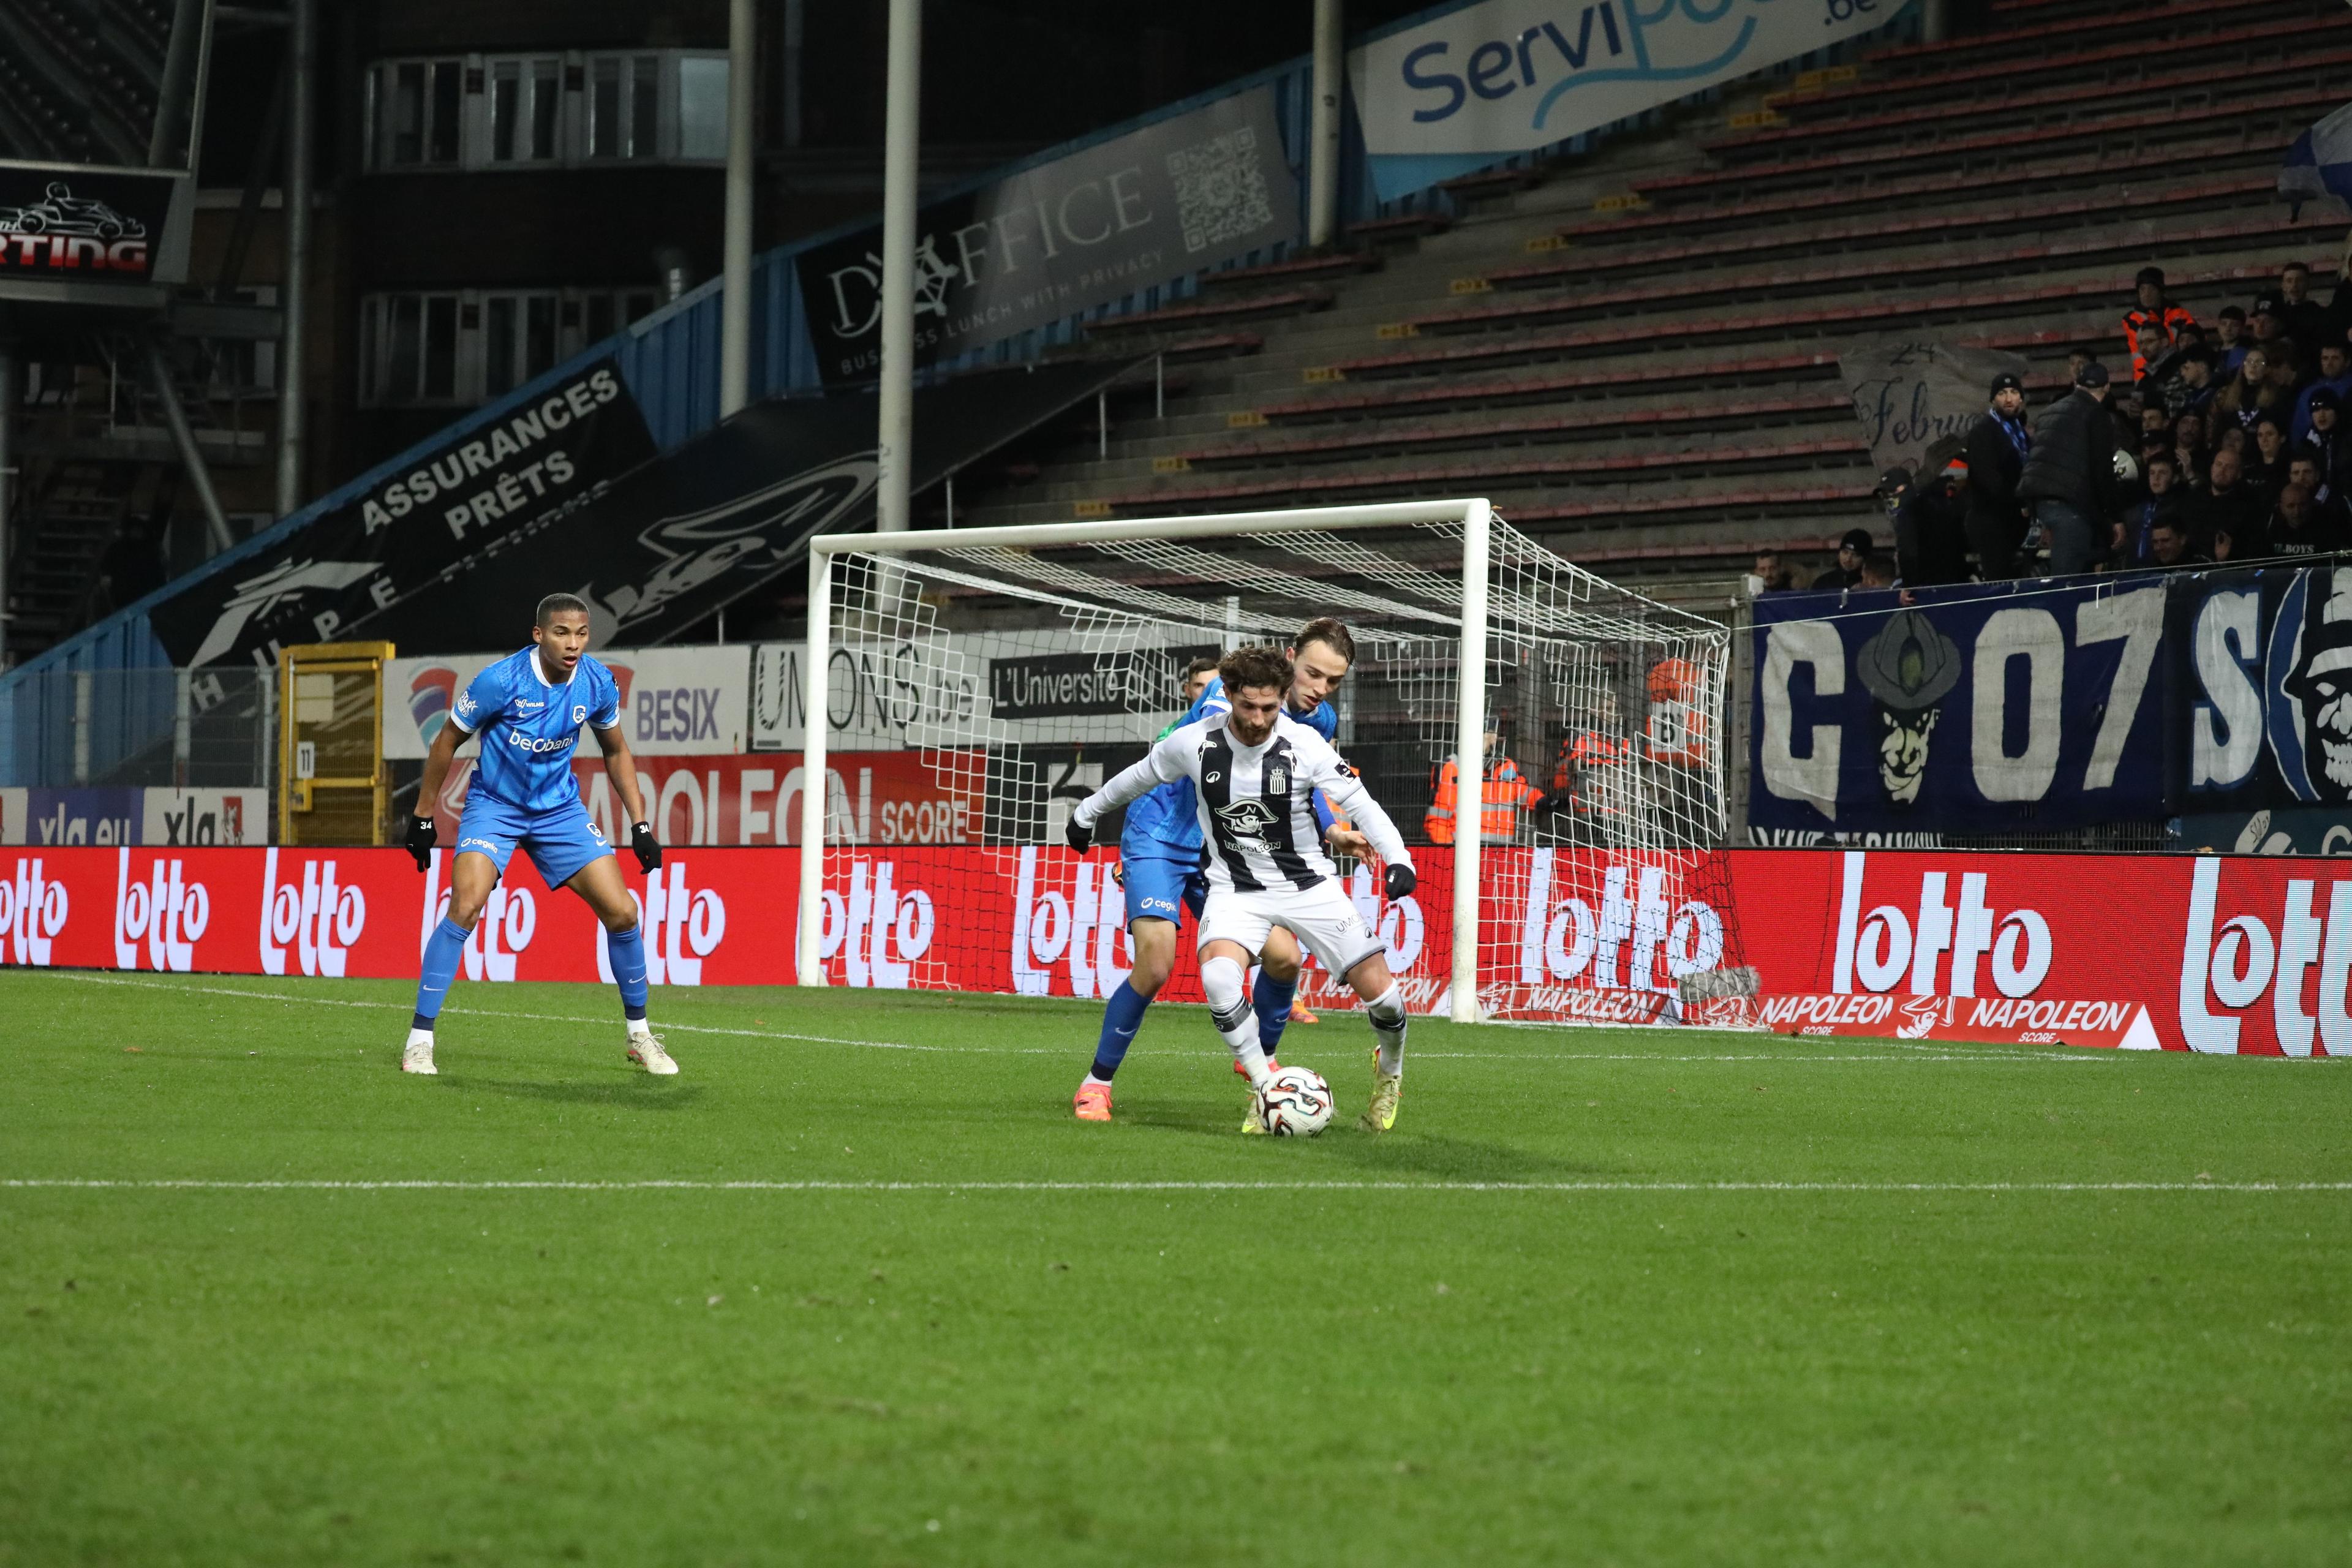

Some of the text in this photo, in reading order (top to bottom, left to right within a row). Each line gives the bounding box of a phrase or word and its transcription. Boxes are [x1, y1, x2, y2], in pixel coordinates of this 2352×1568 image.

[841, 249, 1163, 375] BUSSS LUNCH WITH PRIVACY
[362, 369, 619, 536] ASSURANCES
[444, 450, 575, 541] PRÊTS
[636, 687, 720, 741] BESIX
[1128, 660, 1153, 701] du
[1972, 587, 2166, 801] 07
[164, 796, 216, 845] xla
[420, 821, 432, 830] 34
[472, 838, 499, 854] cegeka
[574, 767, 968, 844] APOLEON SCORE
[639, 824, 650, 834] 34
[1224, 841, 1281, 854] NAPOLEON
[0, 858, 69, 966] otto
[115, 846, 209, 971] lotto
[260, 847, 365, 978] lotto
[795, 862, 935, 989] otto
[1011, 846, 1136, 998] lott
[1521, 848, 1724, 1022] lotto
[1832, 851, 2052, 999] lotto
[2179, 857, 2352, 1057] lott
[1525, 985, 1657, 1022] NAPOLEON
[1801, 1026, 1835, 1036] SCORE
[1967, 998, 2131, 1031] NAPOLEON
[2019, 1032, 2056, 1043] SCORE
